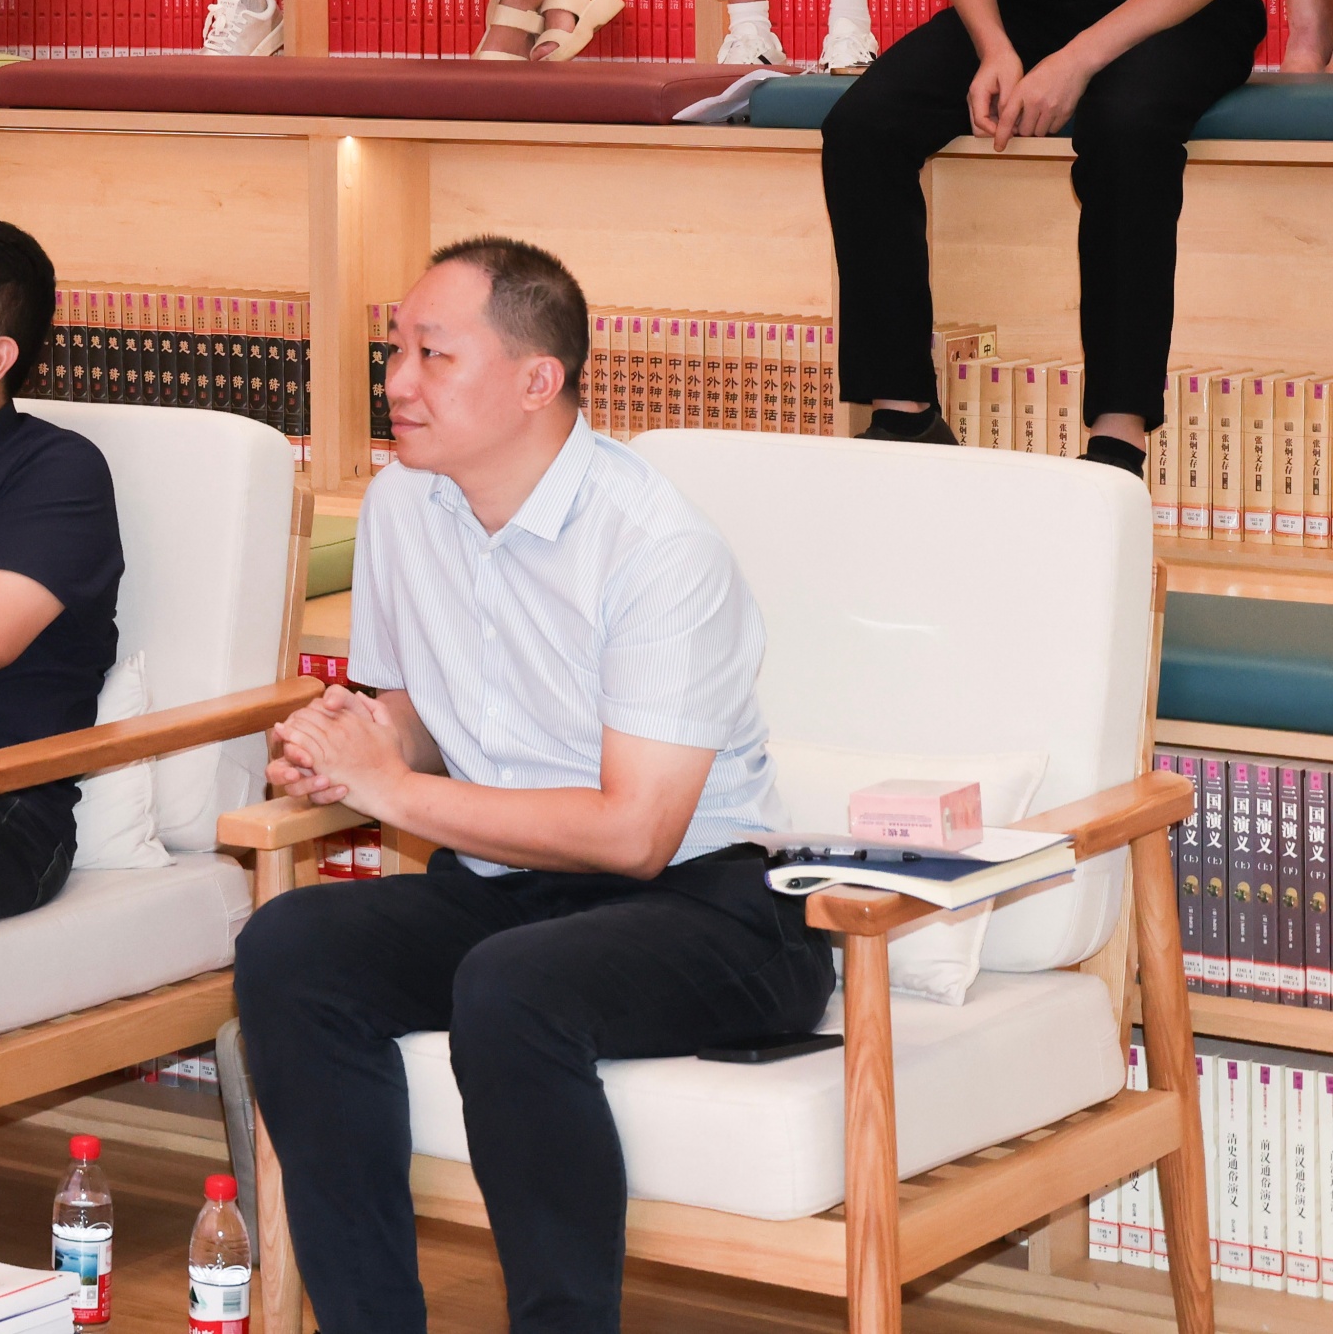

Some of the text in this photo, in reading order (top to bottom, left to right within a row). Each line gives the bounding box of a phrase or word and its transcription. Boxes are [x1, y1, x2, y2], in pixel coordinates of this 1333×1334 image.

[594, 353, 609, 410] 中外神话
[613, 354, 628, 412] 中外神话
[631, 355, 646, 413] 中外神话
[649, 356, 663, 414] 中外神话
[668, 358, 683, 416] 中外神话
[687, 359, 702, 417] 中外神话
[707, 361, 721, 419] 中外神话
[725, 362, 739, 420] 中外神话
[744, 361, 759, 420] 中外神话
[764, 364, 778, 422] 中外神话
[783, 365, 797, 424] 中外神话
[803, 366, 818, 425] 中外神话
[1205, 777, 1223, 849] 三国演义
[1233, 780, 1251, 853] 三国演义
[1256, 782, 1273, 855] 三国演义
[1281, 786, 1298, 859] 三国演义
[1308, 790, 1326, 864] 三国演义
[1227, 1132, 1239, 1209] 清史通俗演义
[1260, 1139, 1272, 1215] 前汉通俗演义
[1295, 1144, 1306, 1220] 前汉通俗演义
